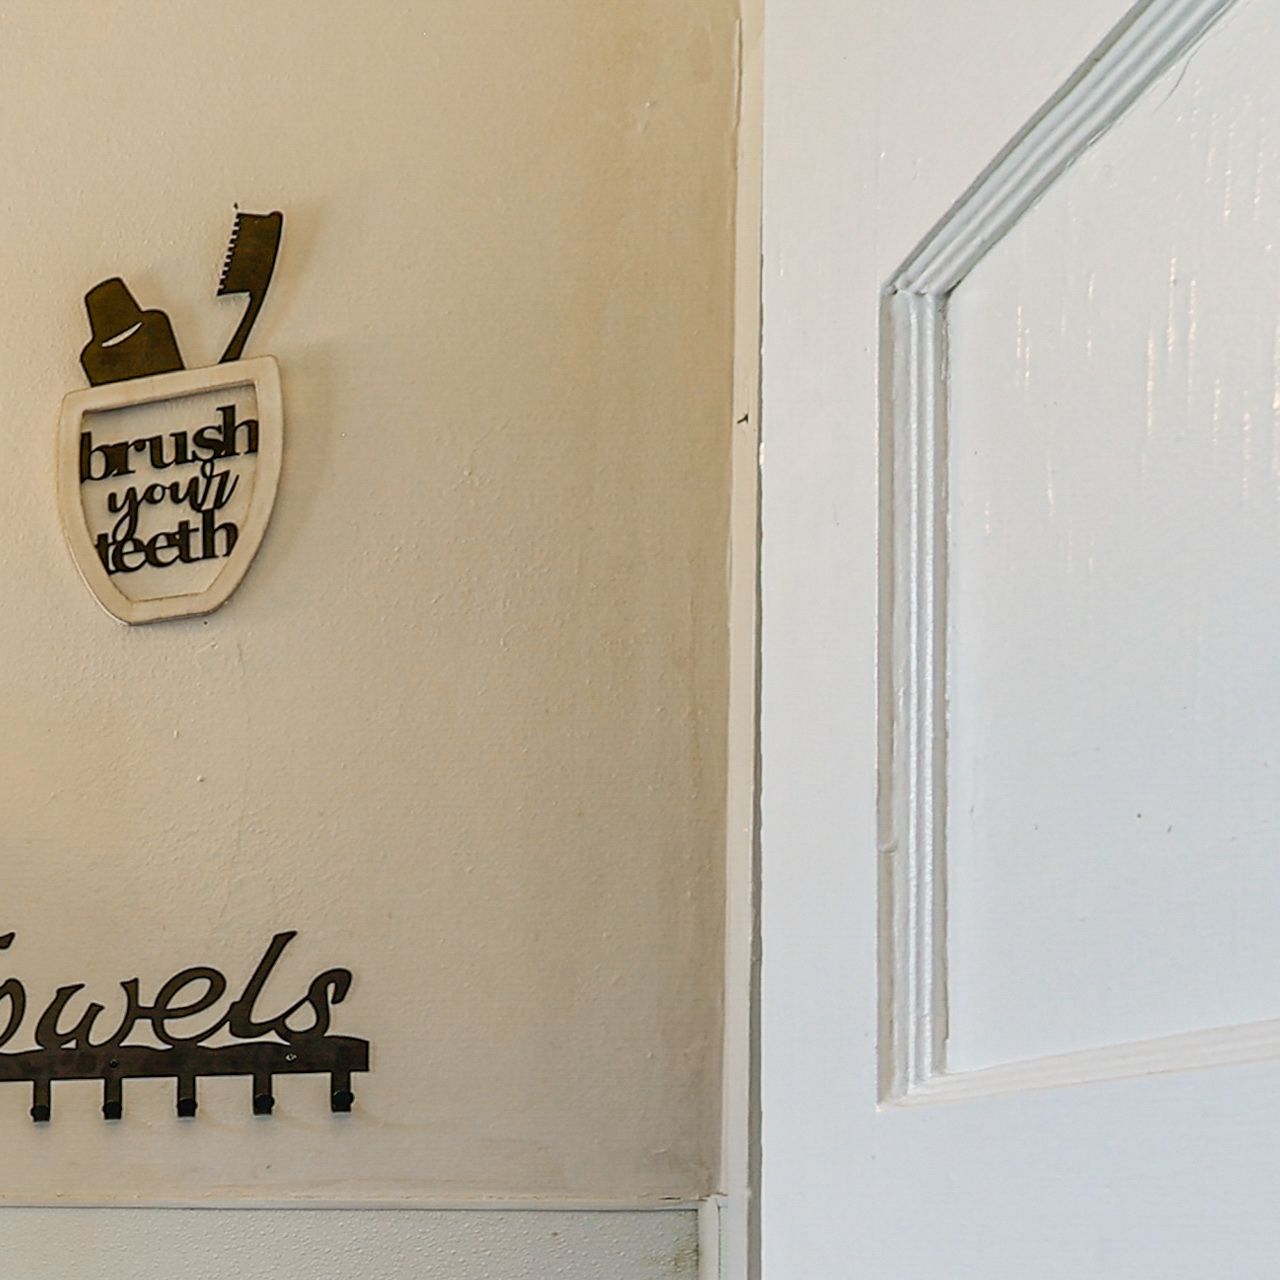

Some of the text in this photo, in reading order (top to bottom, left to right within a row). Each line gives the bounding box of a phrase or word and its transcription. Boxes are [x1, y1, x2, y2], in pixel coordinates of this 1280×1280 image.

[80, 405, 260, 483] brush
[107, 461, 240, 540] your
[95, 507, 239, 575] teeth
